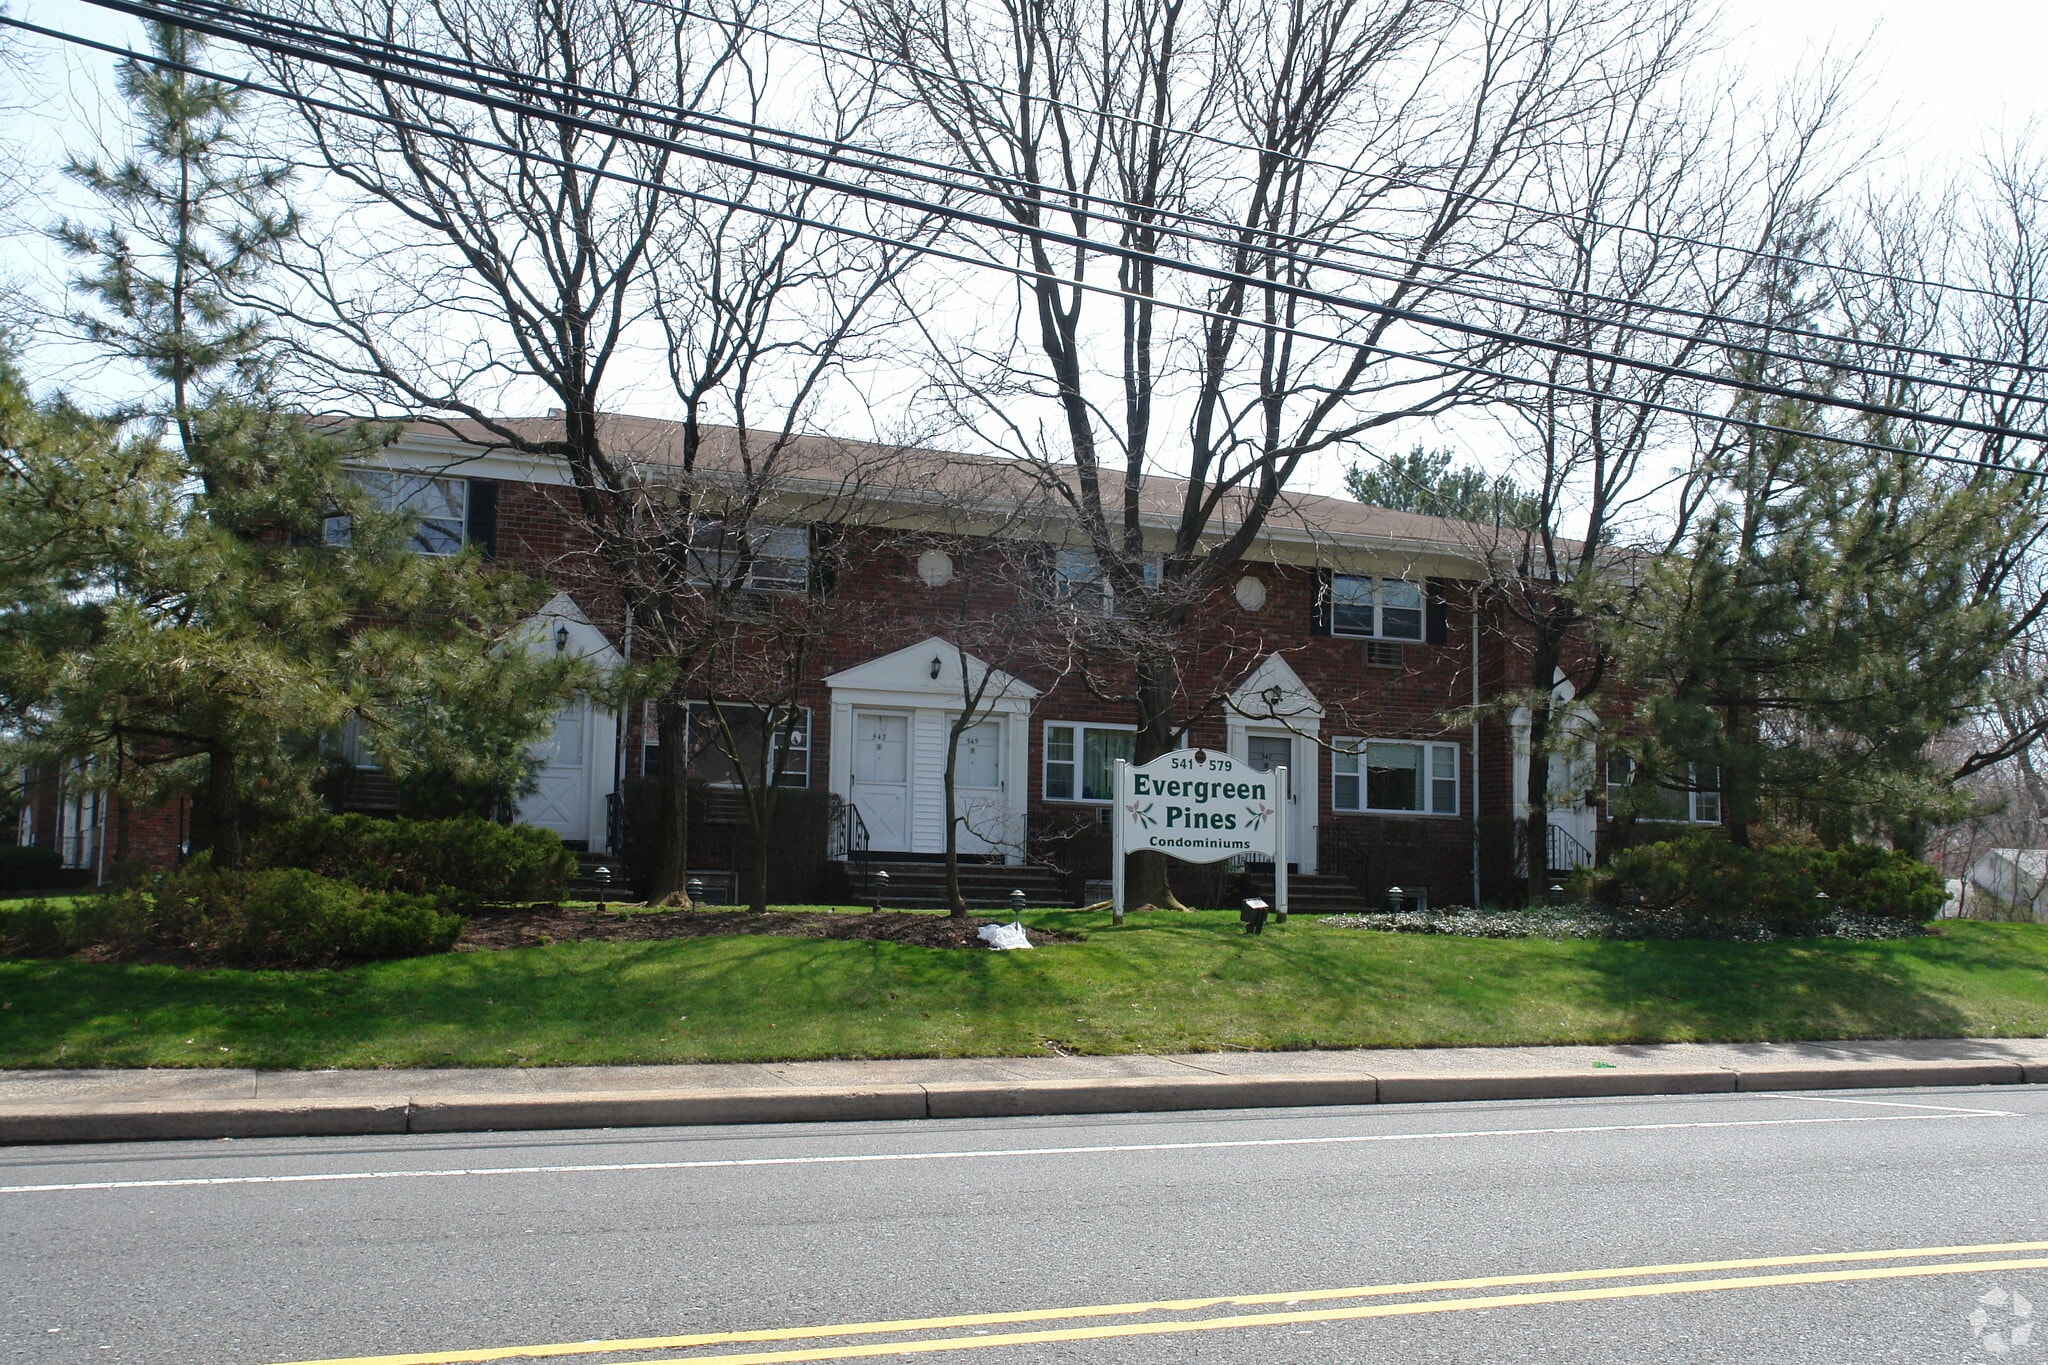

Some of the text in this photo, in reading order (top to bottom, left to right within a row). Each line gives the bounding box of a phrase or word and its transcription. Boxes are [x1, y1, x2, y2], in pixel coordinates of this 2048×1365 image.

[1172, 758, 1193, 770] 541
[1209, 760, 1232, 772] 579
[1134, 774, 1266, 803] Evergreen
[1166, 806, 1237, 830] Pines
[1150, 836, 1250, 849] Condominiums
